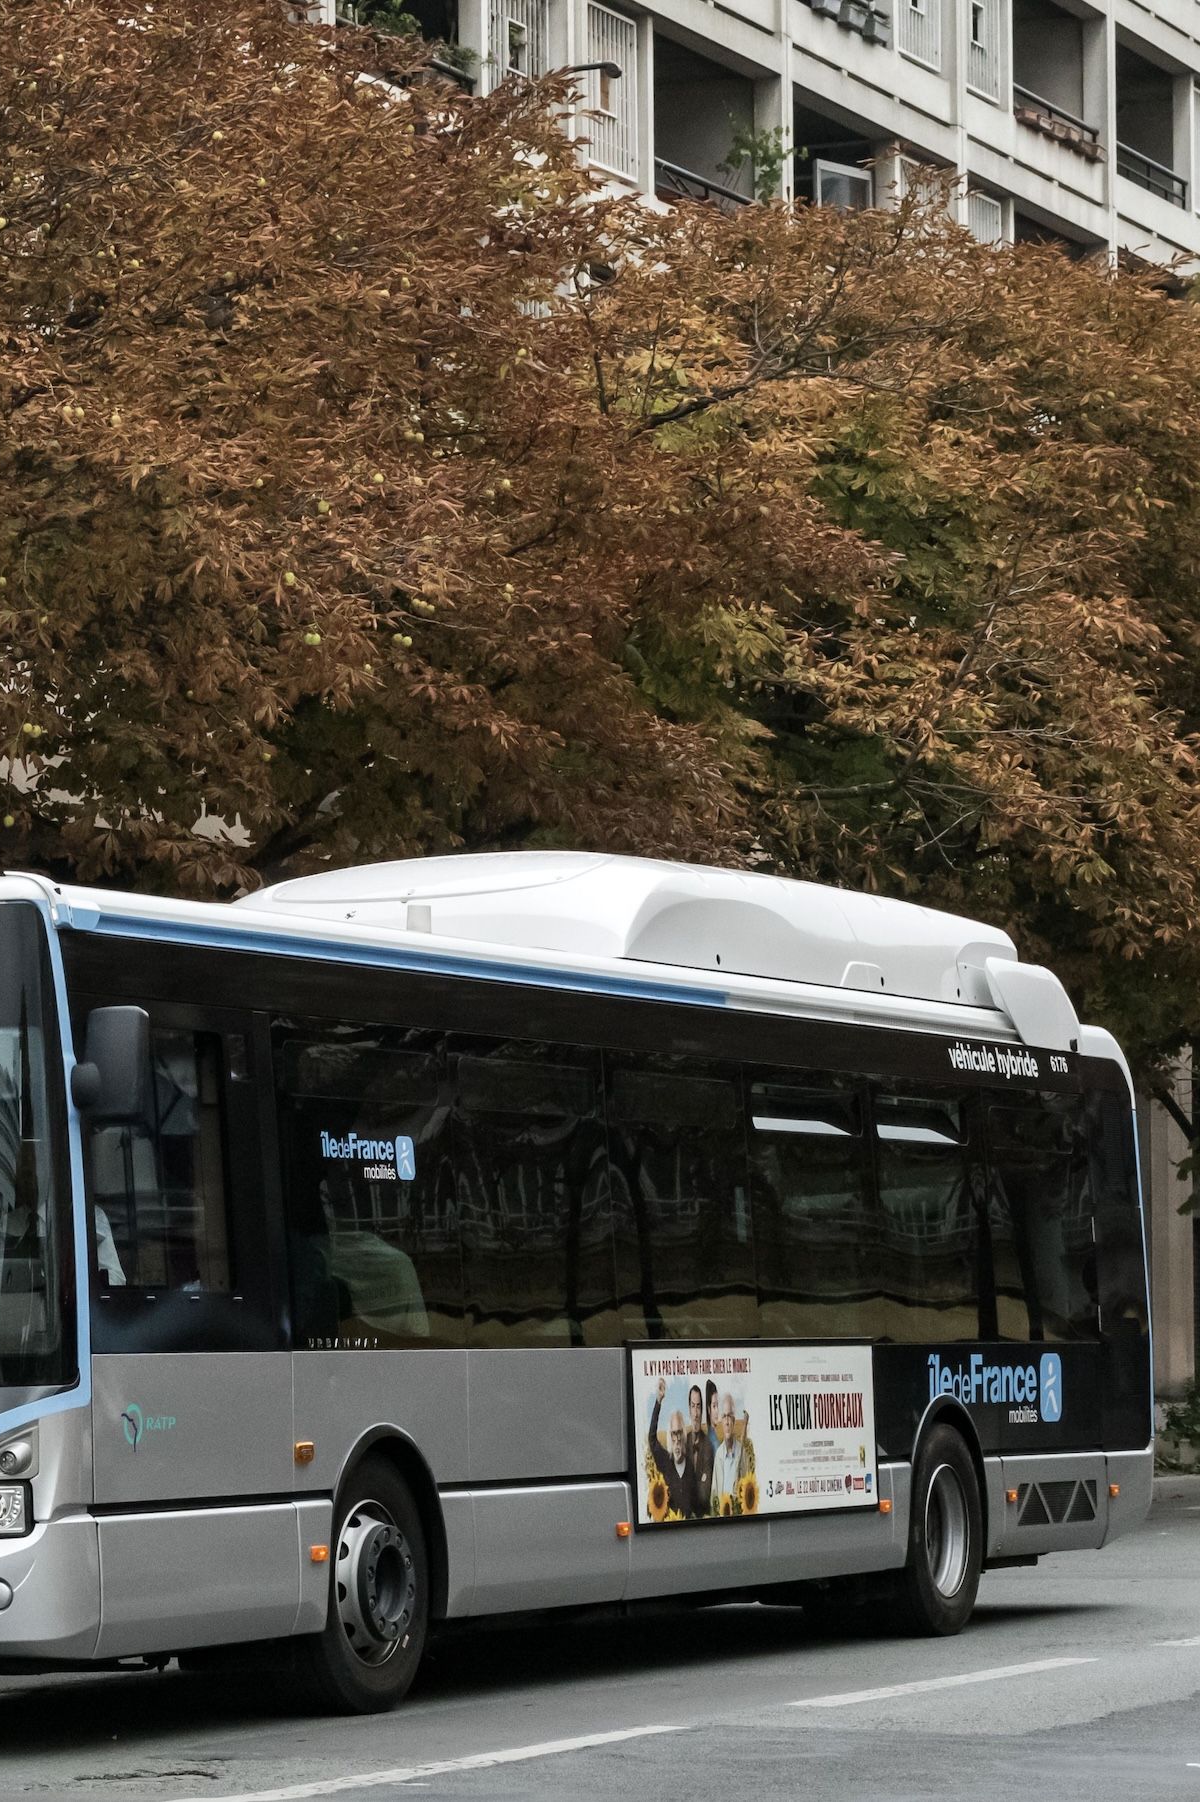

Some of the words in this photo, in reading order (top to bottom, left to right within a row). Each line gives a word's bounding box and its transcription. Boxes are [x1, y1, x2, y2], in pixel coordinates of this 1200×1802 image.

[948, 1041, 996, 1073] véhicule
[995, 1046, 1039, 1079] hybride
[1050, 1055, 1069, 1073] 6176
[363, 1163, 397, 1180] mobilités
[769, 1394, 783, 1431] LES
[785, 1393, 812, 1430] VIEUX
[813, 1392, 864, 1429] FOURNEAUX
[1008, 1404, 1038, 1423] mobilités
[146, 1416, 177, 1430] RATP
